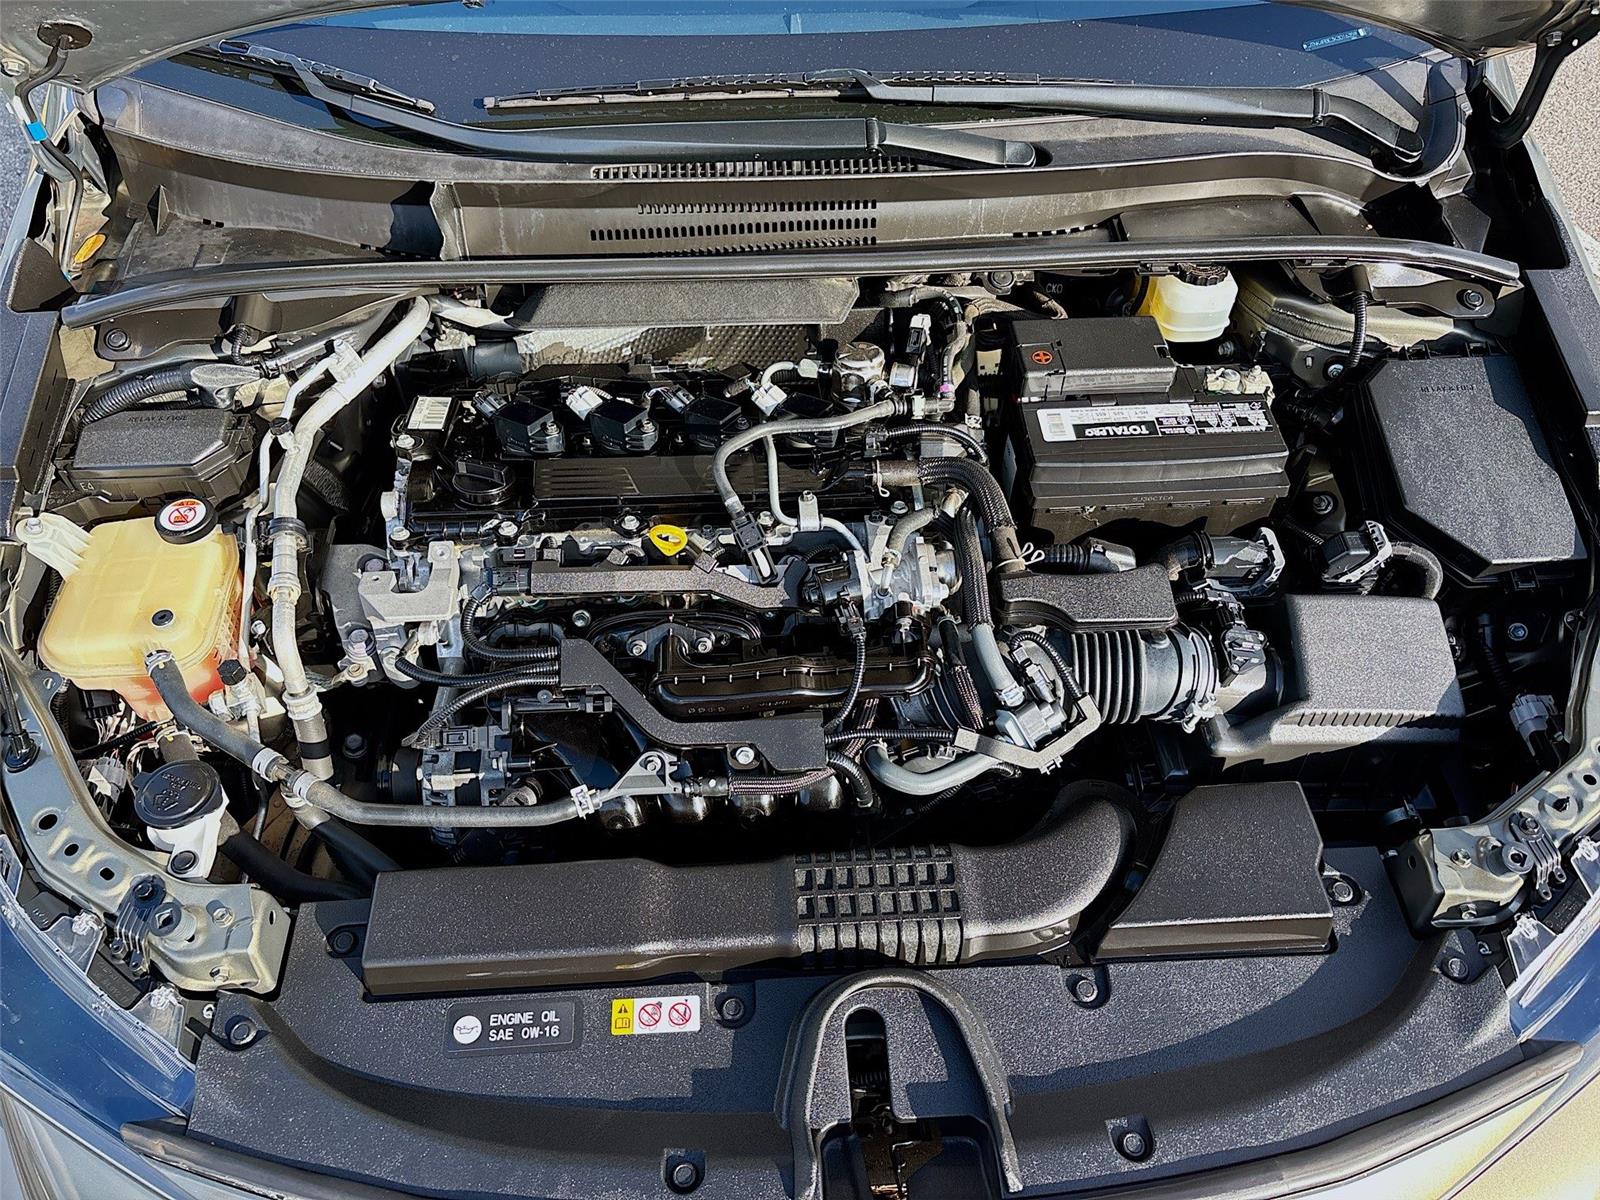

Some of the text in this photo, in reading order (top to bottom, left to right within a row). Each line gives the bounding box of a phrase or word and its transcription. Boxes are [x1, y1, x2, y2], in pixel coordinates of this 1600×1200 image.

[1084, 424, 1150, 437] TOTALPRO
[489, 1010, 561, 1026] ENGINE OIL
[489, 1025, 560, 1042] SAE 0W-16
